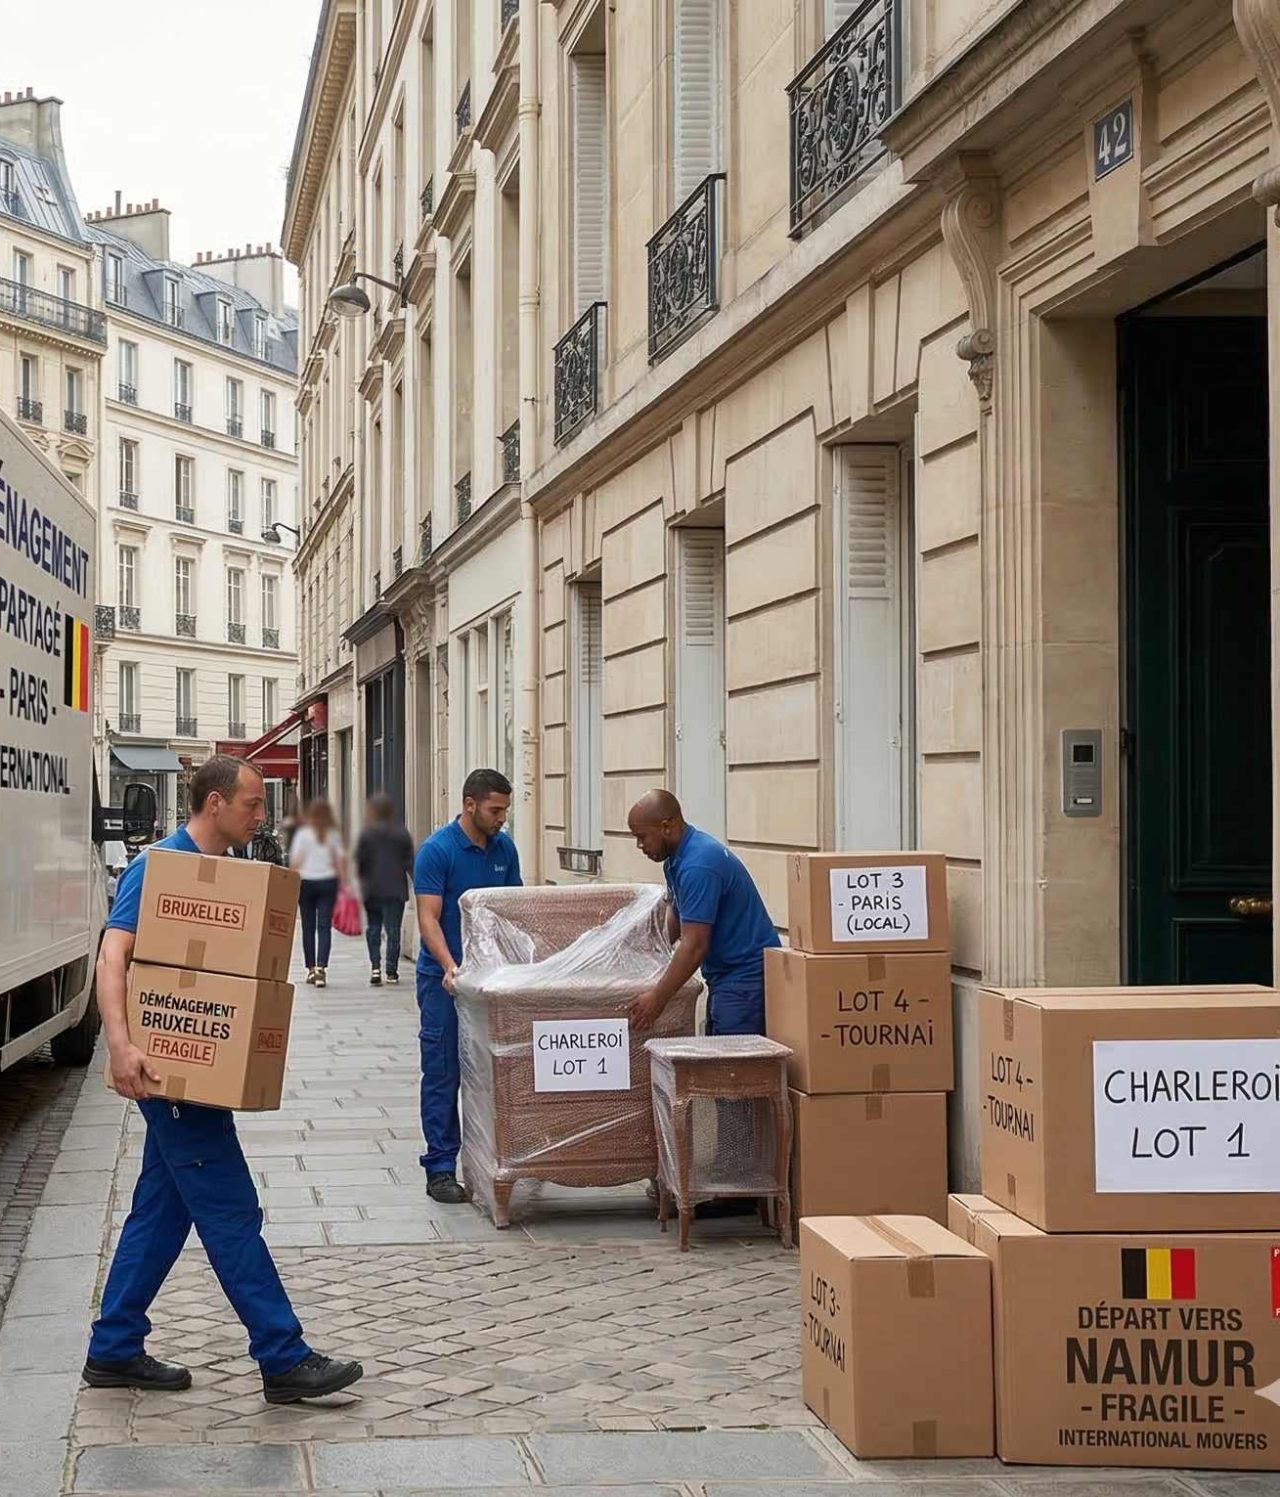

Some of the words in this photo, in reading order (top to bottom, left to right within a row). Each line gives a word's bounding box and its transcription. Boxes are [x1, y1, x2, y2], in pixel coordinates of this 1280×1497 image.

[1098, 112, 1127, 166] 42
[9, 667, 48, 725] PARIS
[847, 873, 882, 889] LOT
[891, 872, 904, 889] 3
[162, 898, 240, 924] BRUXELLES
[847, 913, 911, 935] (LOCAL)
[139, 989, 237, 1019] DÉMÉNAGEMENT
[838, 990, 885, 1012] LOT
[894, 989, 910, 1012] 4
[141, 1010, 231, 1040] BRUXELLES
[152, 1038, 212, 1061] FRAGILE
[553, 1059, 588, 1075] LOT
[597, 1057, 608, 1074] 1
[991, 1052, 1013, 1086] LOT
[1131, 1126, 1207, 1158] LOT
[1227, 1122, 1251, 1157] 1
[811, 1271, 827, 1311] LOT
[1078, 1301, 1171, 1330] DÉPART
[1179, 1308, 1243, 1331] VERS
[1066, 1337, 1256, 1387] NAMUR
[1101, 1393, 1225, 1424] FRAGILE
[1058, 1429, 1191, 1449] INTERNATIONAL
[1197, 1432, 1268, 1450] MOVERS
